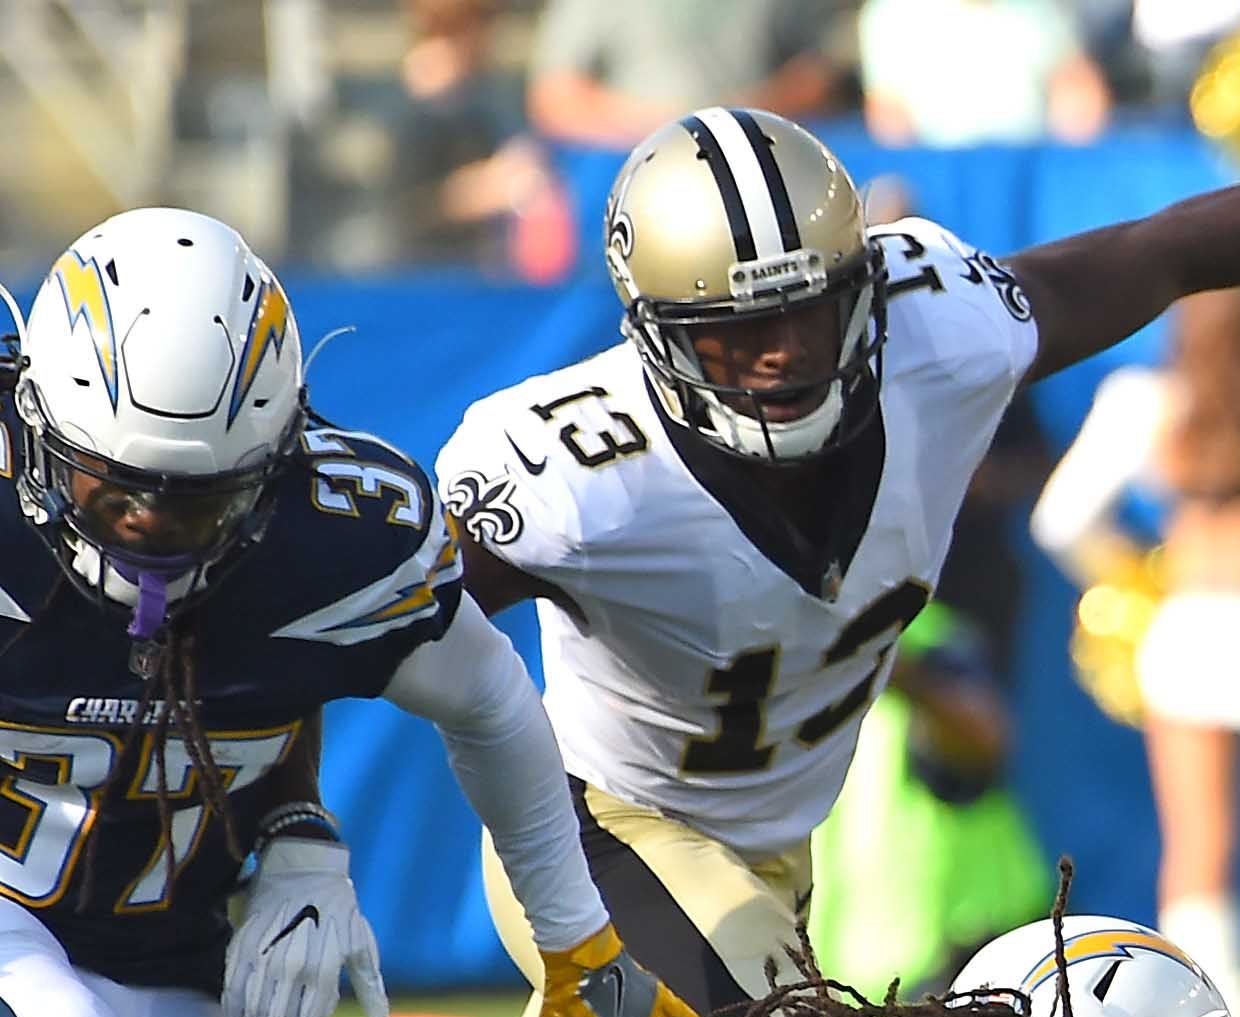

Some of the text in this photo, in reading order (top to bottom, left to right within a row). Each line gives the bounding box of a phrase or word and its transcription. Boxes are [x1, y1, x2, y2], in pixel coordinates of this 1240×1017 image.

[751, 261, 799, 280] SAINTS
[529, 385, 650, 468] 13
[300, 427, 426, 531] 37
[0, 719, 303, 915] 37
